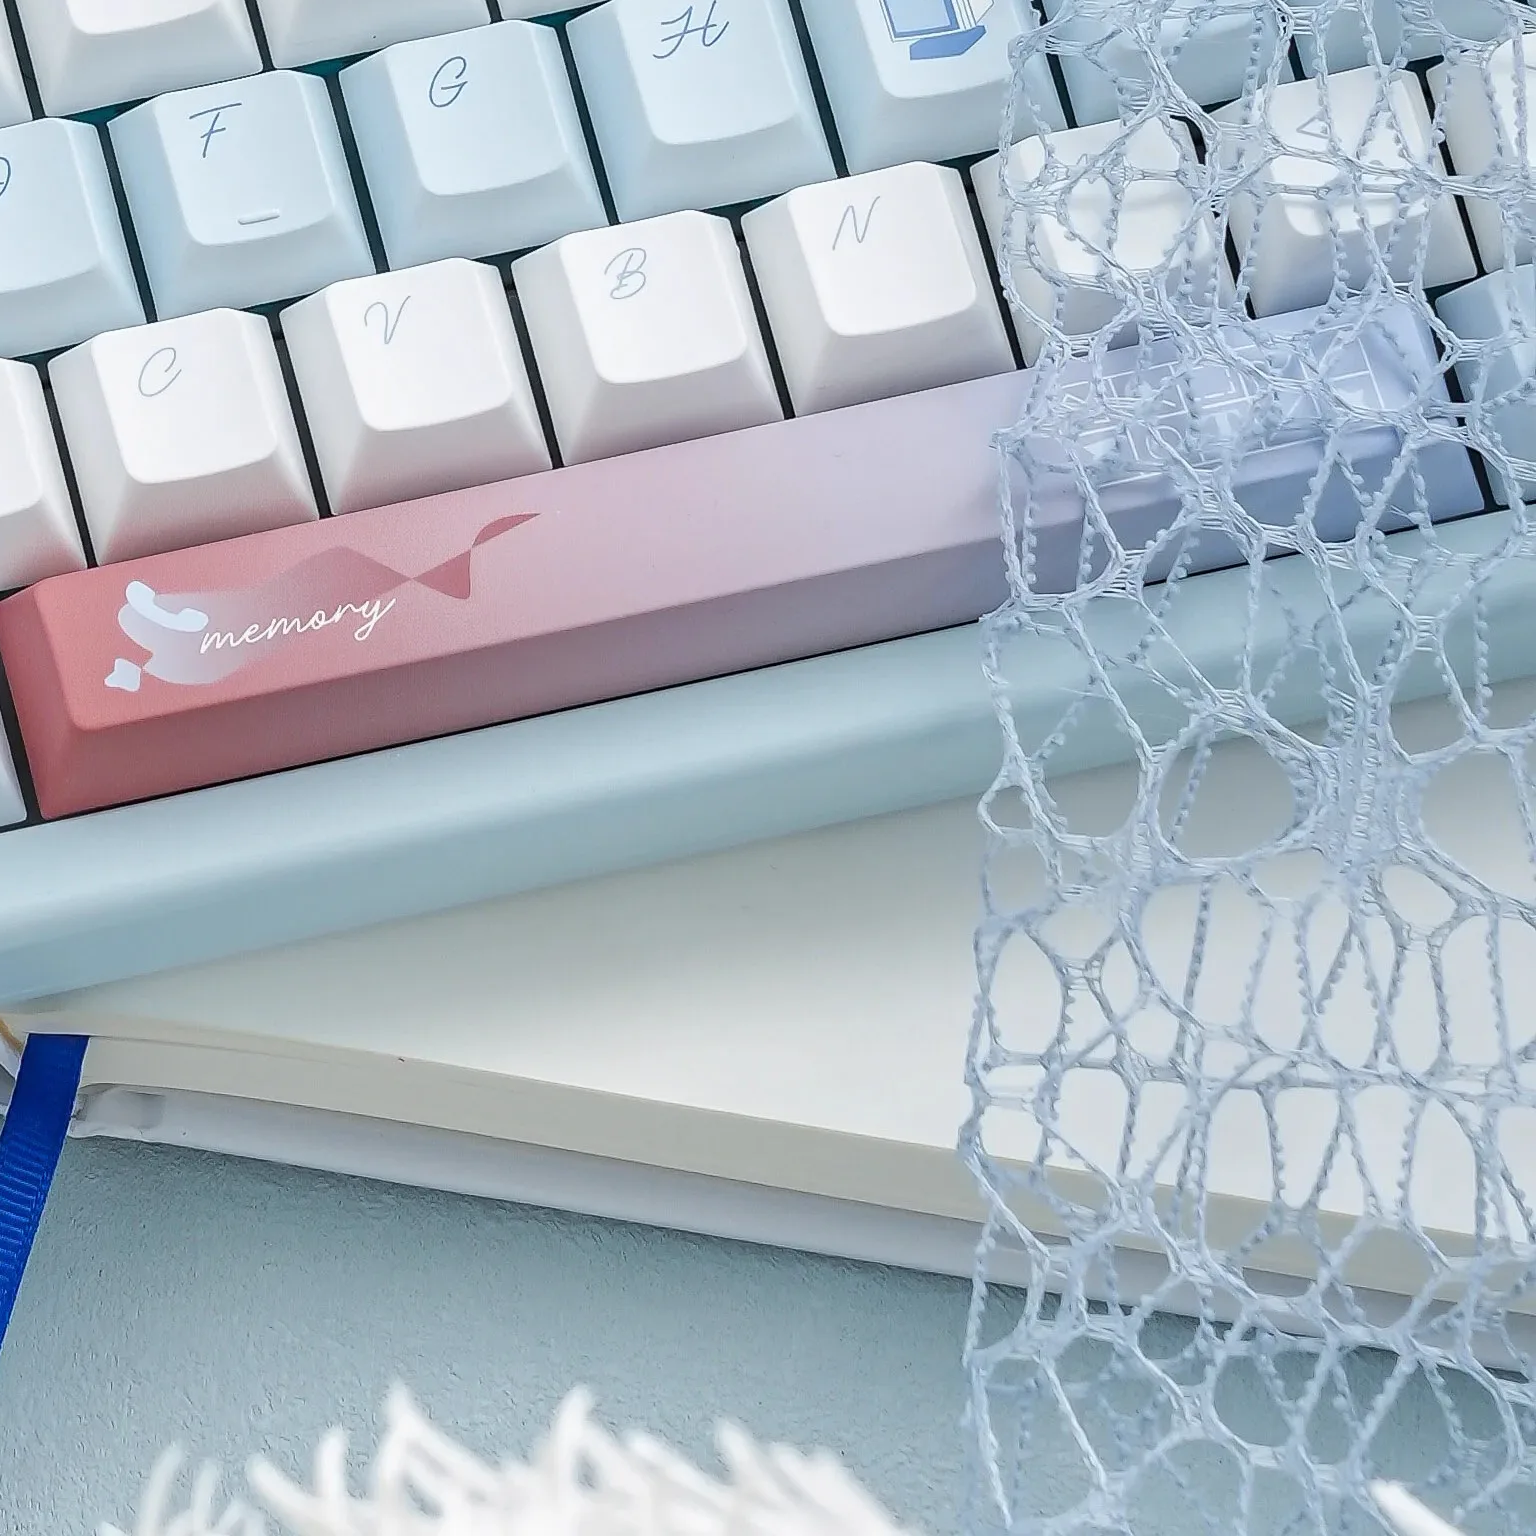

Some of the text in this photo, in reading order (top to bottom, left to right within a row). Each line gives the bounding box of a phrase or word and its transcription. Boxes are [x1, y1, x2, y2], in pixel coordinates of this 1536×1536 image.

[428, 55, 470, 109] G
[188, 102, 243, 159] F
[831, 195, 882, 252] N
[603, 247, 649, 300] B
[363, 295, 413, 346] V
[199, 596, 398, 655] memory
